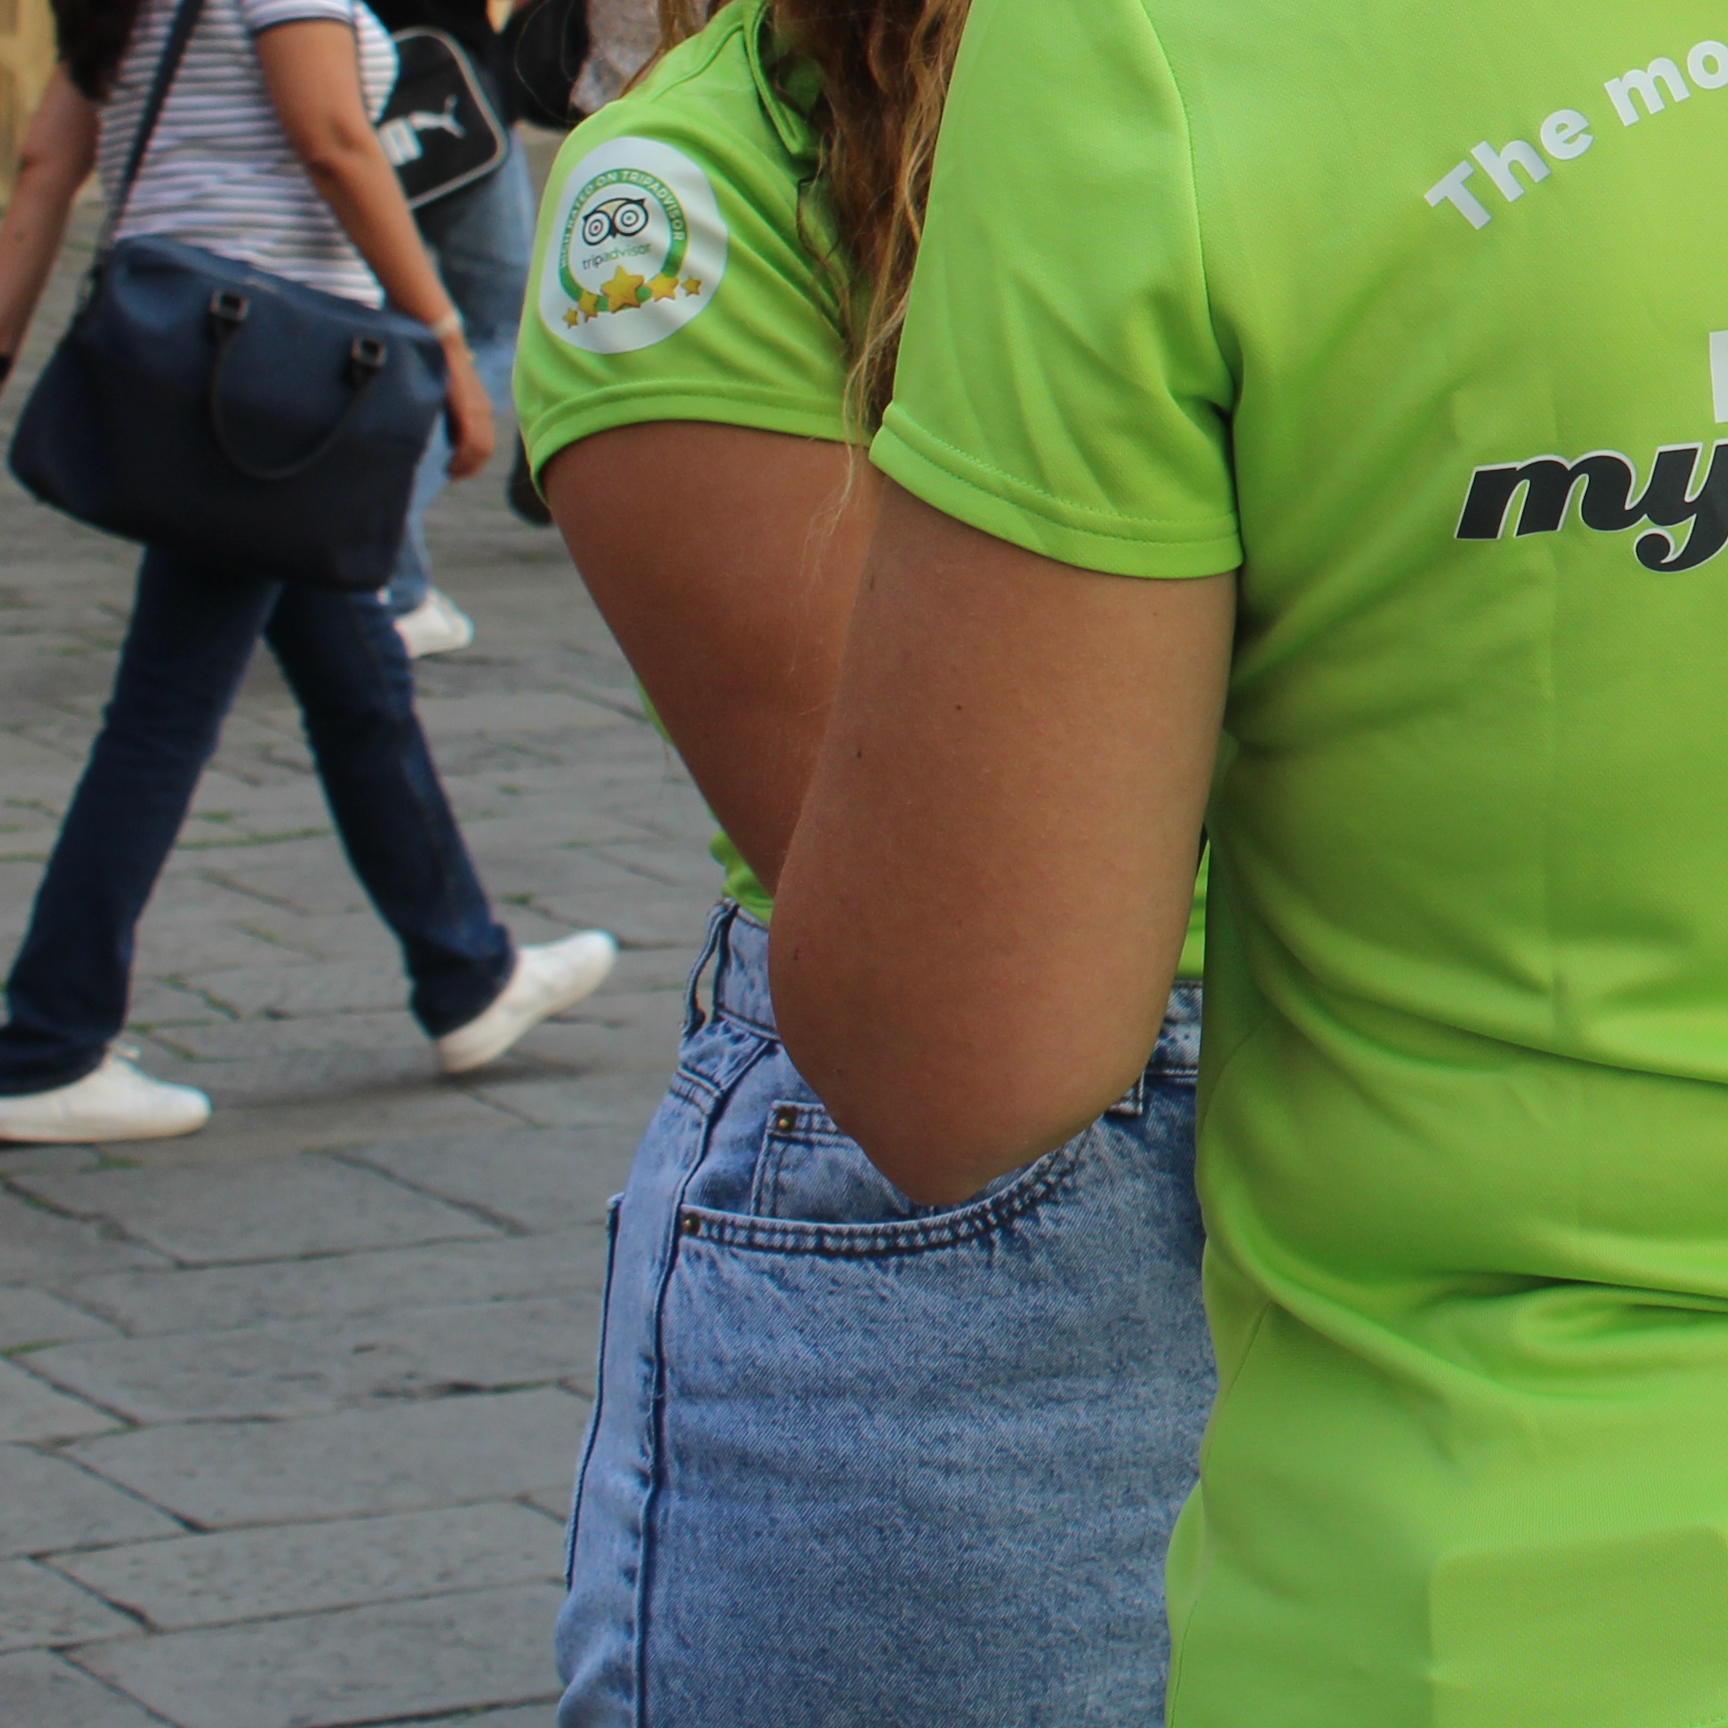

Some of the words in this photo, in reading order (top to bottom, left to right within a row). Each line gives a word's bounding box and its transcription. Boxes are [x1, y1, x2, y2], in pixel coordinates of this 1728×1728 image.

[1424, 109, 1594, 229] The
[595, 171, 618, 187] ON
[621, 170, 685, 241] TRIPADVISOR
[582, 243, 651, 271] tripadvisor
